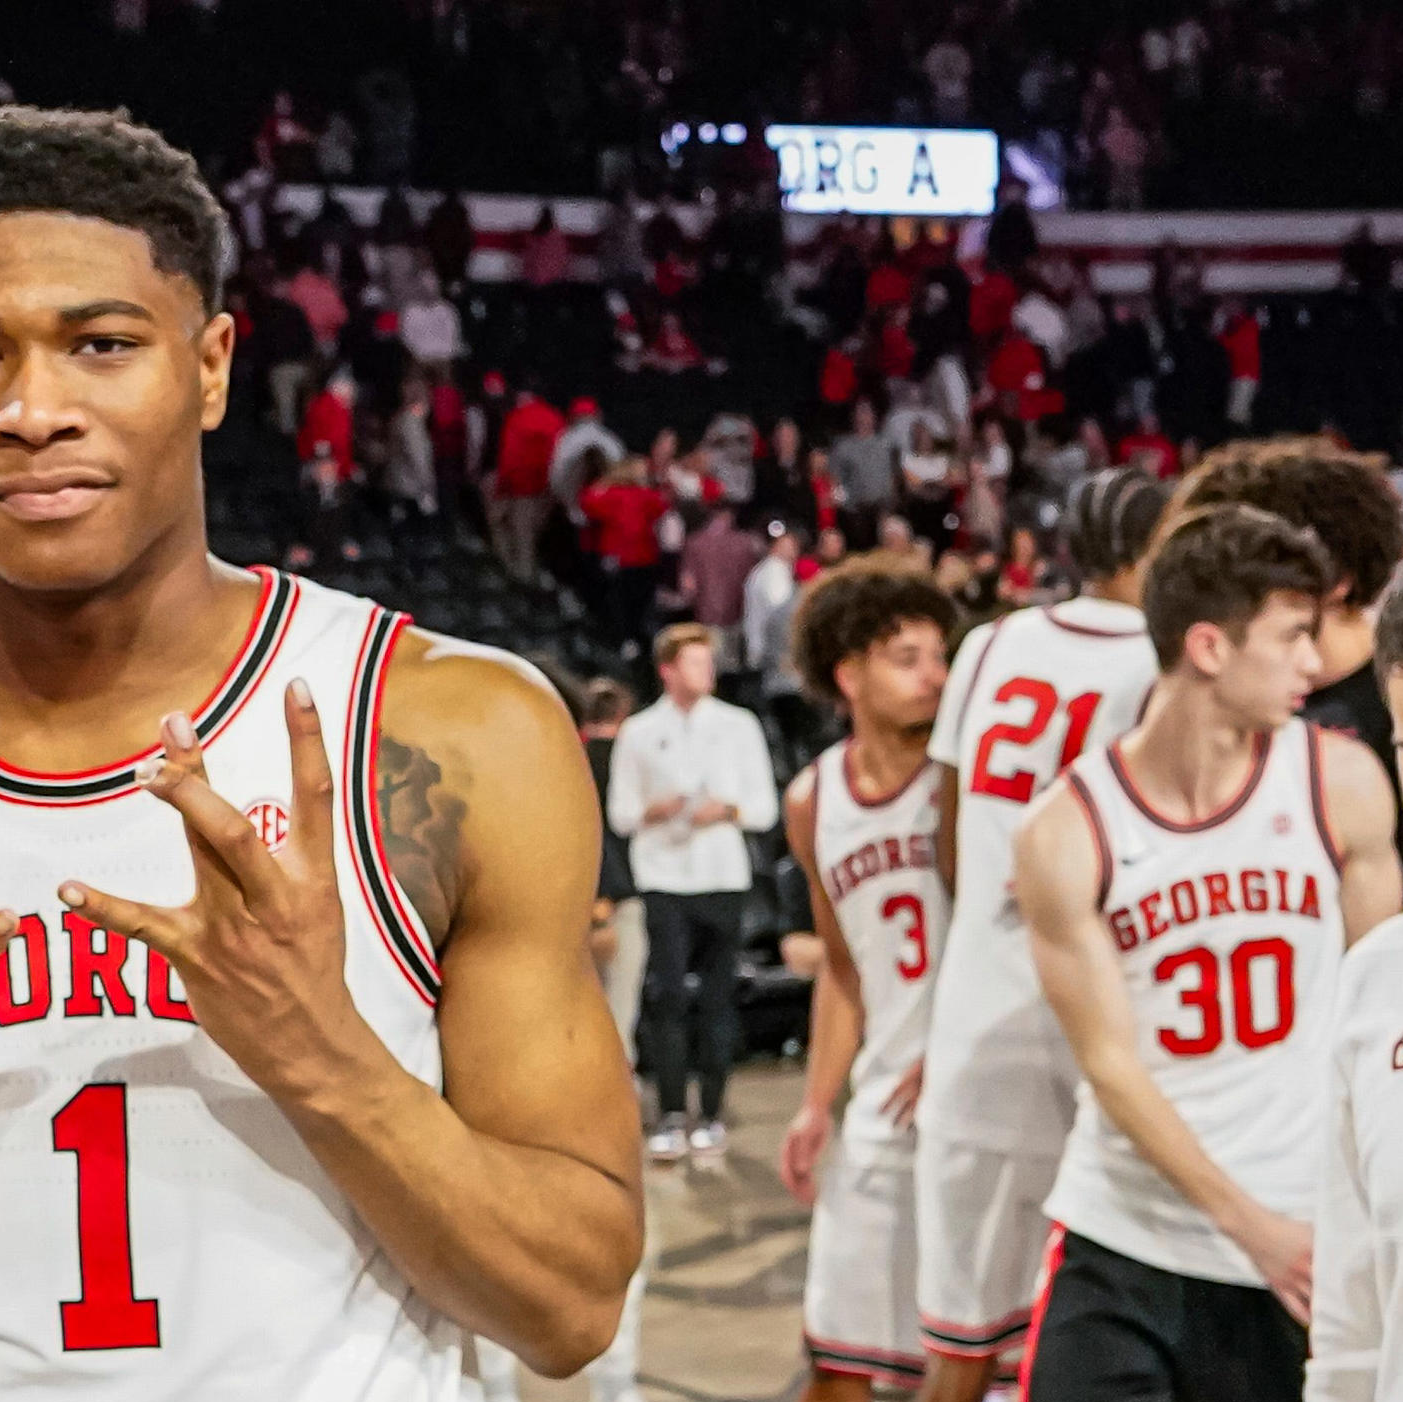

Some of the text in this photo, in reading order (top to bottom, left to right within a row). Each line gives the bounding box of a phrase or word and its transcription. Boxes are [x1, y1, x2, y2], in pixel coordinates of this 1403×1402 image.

[970, 676, 1102, 803] 21
[881, 894, 927, 979] 3
[1109, 869, 1321, 952] GEORGIA
[1154, 936, 1295, 1055] 30
[51, 1082, 161, 1351] 1
